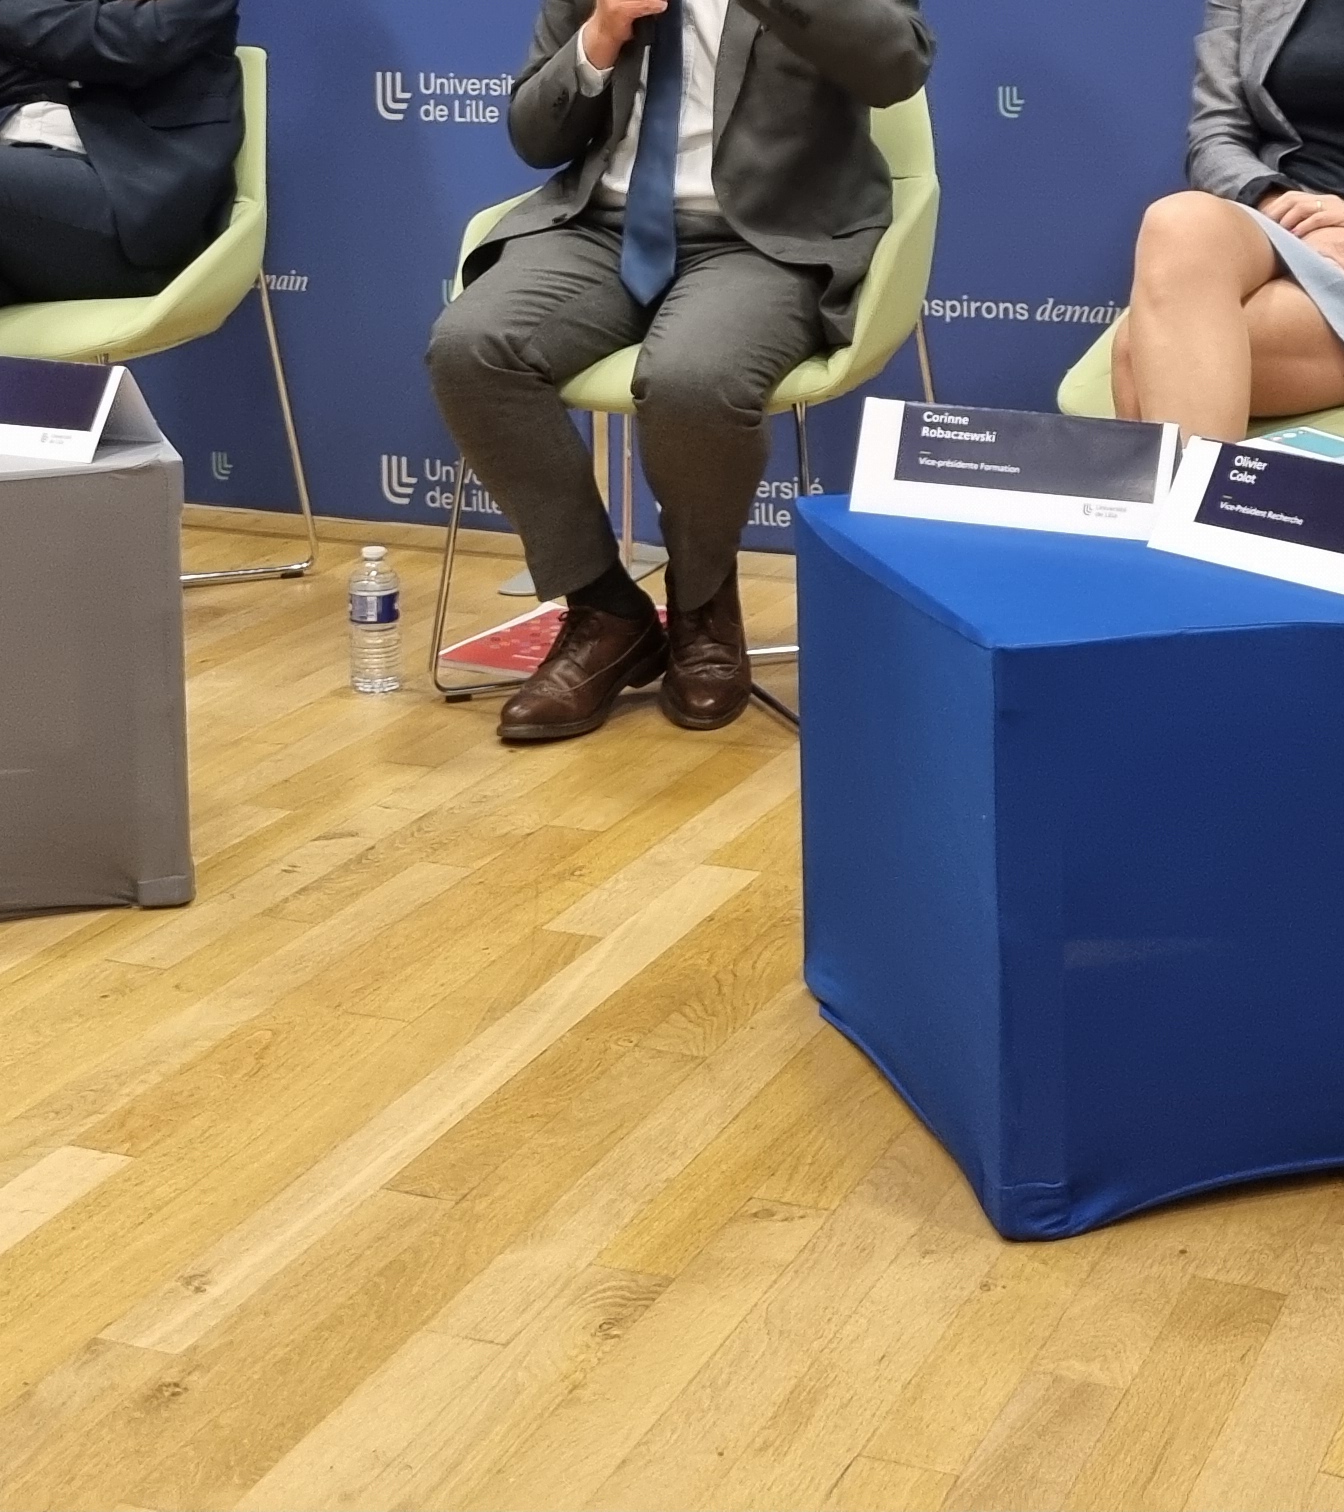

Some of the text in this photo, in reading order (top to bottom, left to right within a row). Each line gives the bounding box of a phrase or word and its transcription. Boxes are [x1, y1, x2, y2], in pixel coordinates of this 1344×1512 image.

[419, 98, 500, 124] de Lille
[922, 411, 970, 425] Corinne
[921, 426, 996, 443] Robaczewski
[979, 462, 1021, 474] Formation
[1234, 455, 1268, 471] Olivier
[1229, 469, 1257, 485] Colot
[425, 485, 454, 510] de
[747, 501, 792, 528] ille
